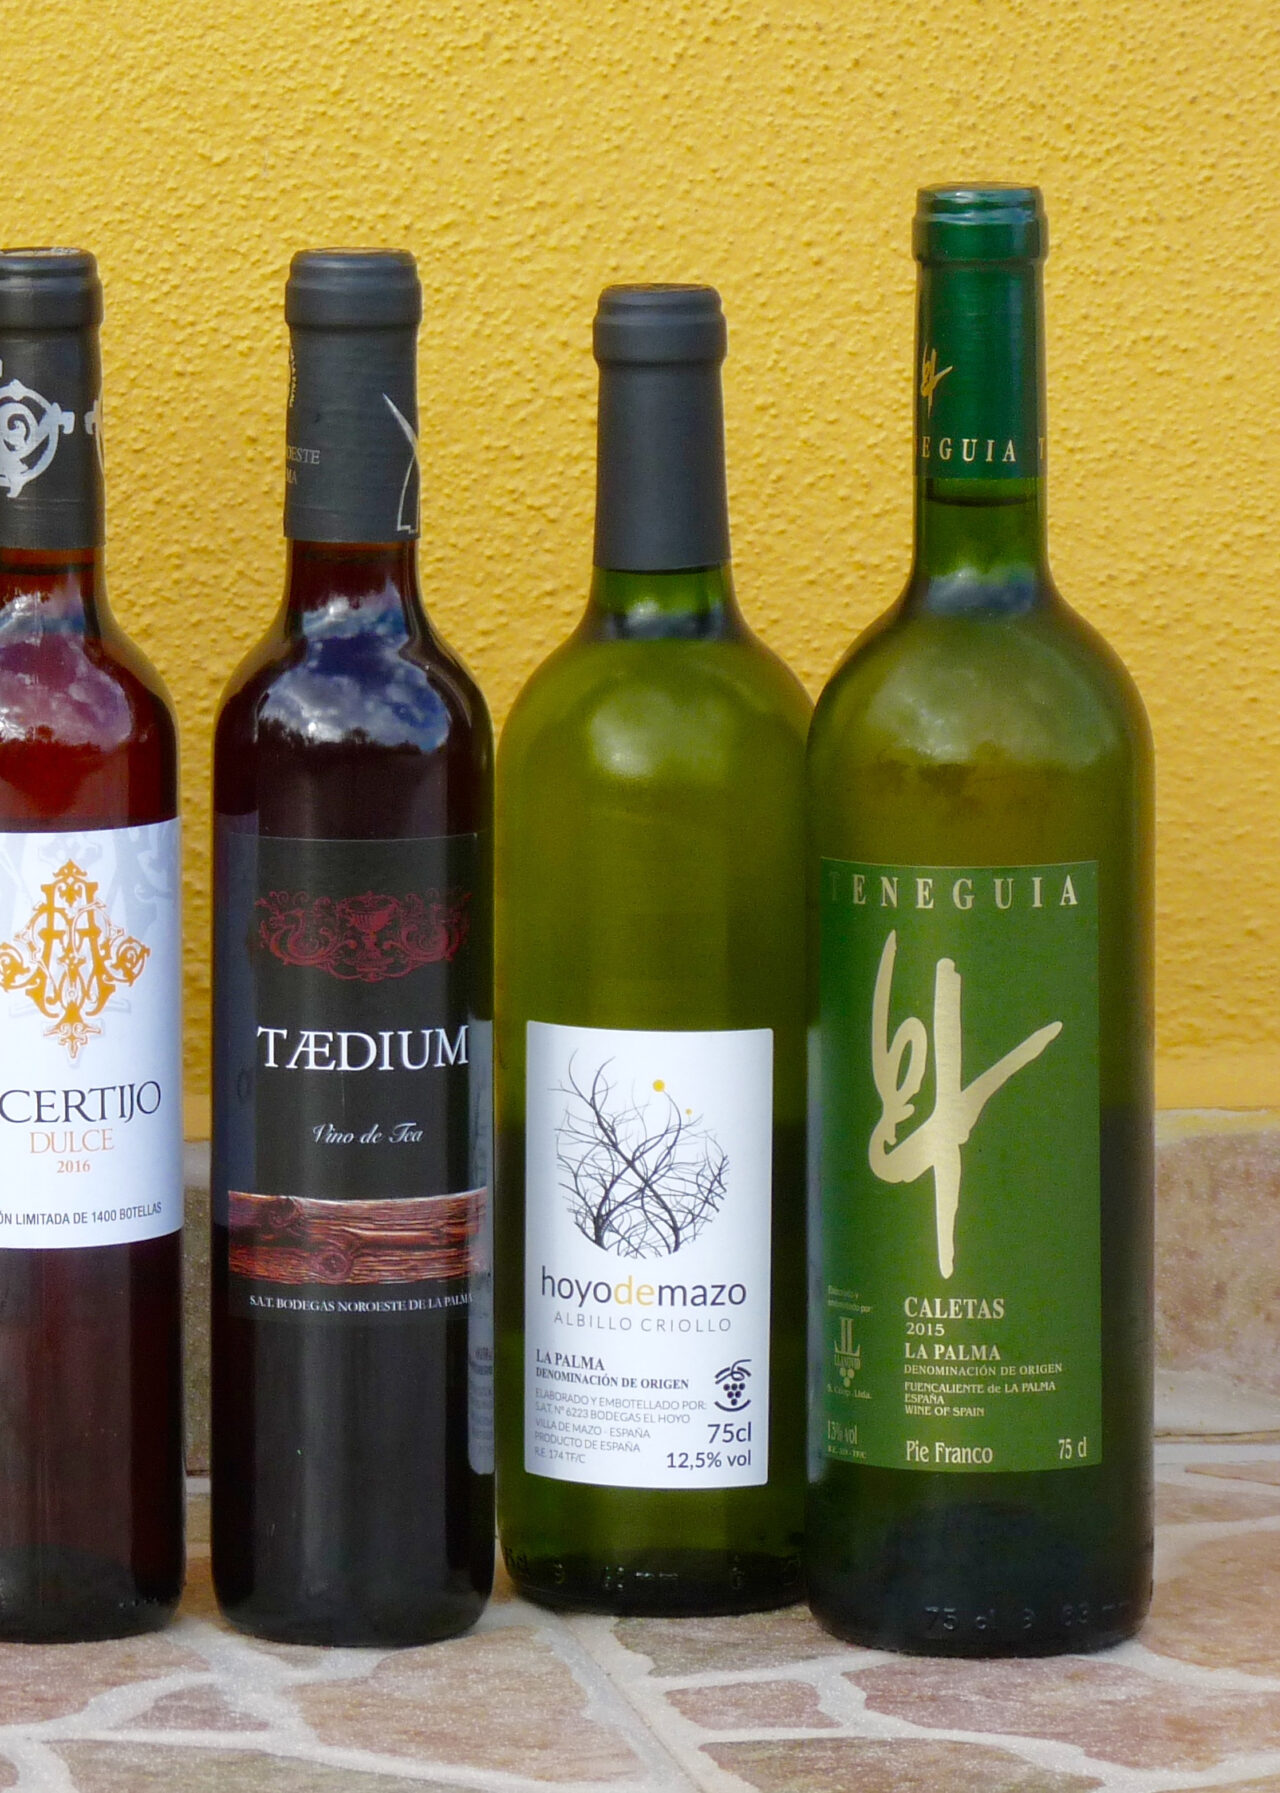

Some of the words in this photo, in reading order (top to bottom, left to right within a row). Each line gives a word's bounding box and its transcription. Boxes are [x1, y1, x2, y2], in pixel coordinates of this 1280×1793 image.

[922, 436, 1016, 462] EGUIA
[257, 1025, 469, 1071] TÆDIUM
[29, 1128, 115, 1154] DULCE
[312, 1123, 354, 1144] Vino
[360, 1123, 383, 1144] de
[388, 1122, 423, 1143] Tea
[56, 1159, 91, 1174] 2016
[16, 1213, 70, 1225] LIMITADA
[73, 1212, 88, 1224] DE
[92, 1210, 116, 1223] 1400
[120, 1201, 162, 1221] BOTELLAS
[276, 1298, 335, 1312] BODEGAS
[337, 1300, 407, 1312] NOROESTE
[409, 1299, 426, 1310] DE
[428, 1297, 442, 1309] LA
[904, 1297, 1005, 1320] CALETAS
[554, 1311, 632, 1331] ALBILLO
[640, 1318, 731, 1332] CRIOLLO
[906, 1322, 945, 1337] 2015
[536, 1349, 552, 1365] LA
[555, 1352, 605, 1371] PALMA
[905, 1343, 928, 1360] LA
[934, 1344, 1001, 1361] PALMA
[536, 1367, 618, 1387] DENOMINACIÓN
[621, 1378, 637, 1388] DE
[641, 1378, 689, 1390] ORIGEN
[904, 1364, 996, 1376] DENOMINACIÓN
[1000, 1366, 1016, 1376] DE
[1019, 1363, 1063, 1375] ORIGEN
[904, 1381, 985, 1394] FUENCALIENTE
[987, 1384, 1001, 1394] de
[1004, 1383, 1019, 1393] LA
[1022, 1381, 1056, 1392] PALMA
[535, 1388, 589, 1405] ELABORADO
[590, 1396, 598, 1405] Y
[599, 1397, 680, 1410] EMBOTELLADO
[905, 1393, 945, 1405] ESPAÑA
[566, 1407, 589, 1418] 6223
[590, 1410, 641, 1423] BODEGAS
[643, 1414, 656, 1423] EL
[658, 1414, 691, 1424] HOYO
[905, 1405, 932, 1416] WINE
[934, 1406, 950, 1416] OF
[953, 1407, 985, 1416] SPAIN
[535, 1417, 557, 1430] VILLA
[558, 1421, 571, 1432] DE
[573, 1424, 602, 1436] MAZO
[610, 1426, 651, 1439] ESPAÑA
[707, 1421, 752, 1444] 75cl
[535, 1431, 582, 1448] PRODUCTO
[584, 1439, 598, 1450] DE
[600, 1440, 641, 1453] ESPAÑA
[906, 1440, 929, 1462] Pie
[935, 1442, 993, 1464] Franco
[1058, 1438, 1072, 1460] 75
[667, 1450, 722, 1471] 12,5%
[727, 1449, 752, 1467] vol
